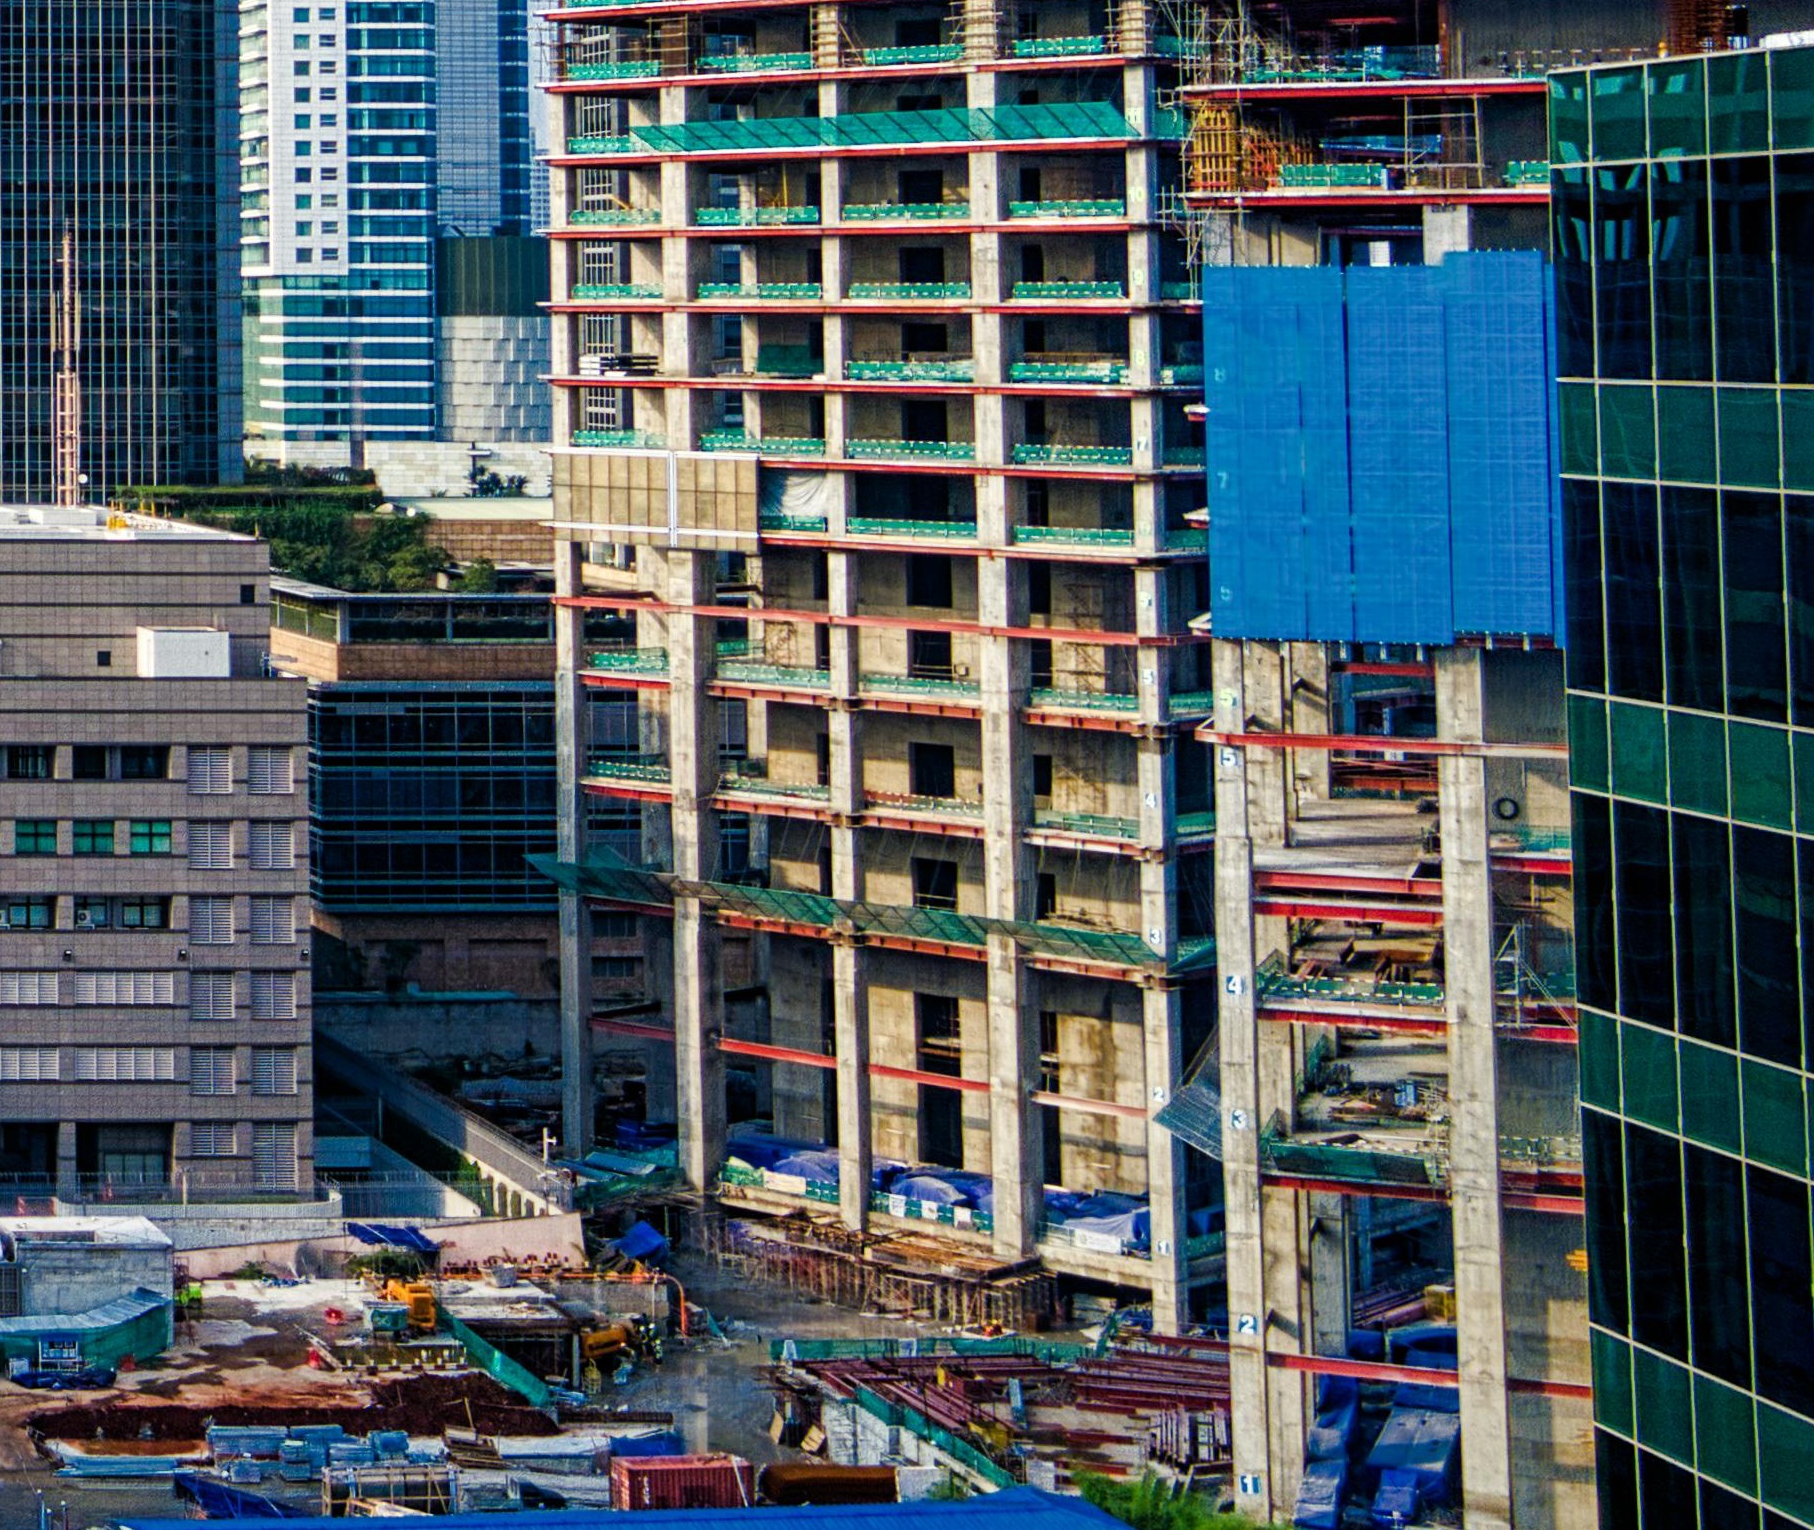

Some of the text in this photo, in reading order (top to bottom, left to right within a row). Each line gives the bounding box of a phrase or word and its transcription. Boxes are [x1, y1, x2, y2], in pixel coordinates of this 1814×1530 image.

[1137, 436, 1148, 451] 7
[1223, 749, 1236, 766] 5
[1145, 793, 1157, 809] 4
[1150, 928, 1160, 945] 3
[1229, 975, 1243, 995] 4
[1153, 1086, 1165, 1103] 2
[1232, 1109, 1247, 1129] 3
[1240, 1315, 1254, 1334] 2
